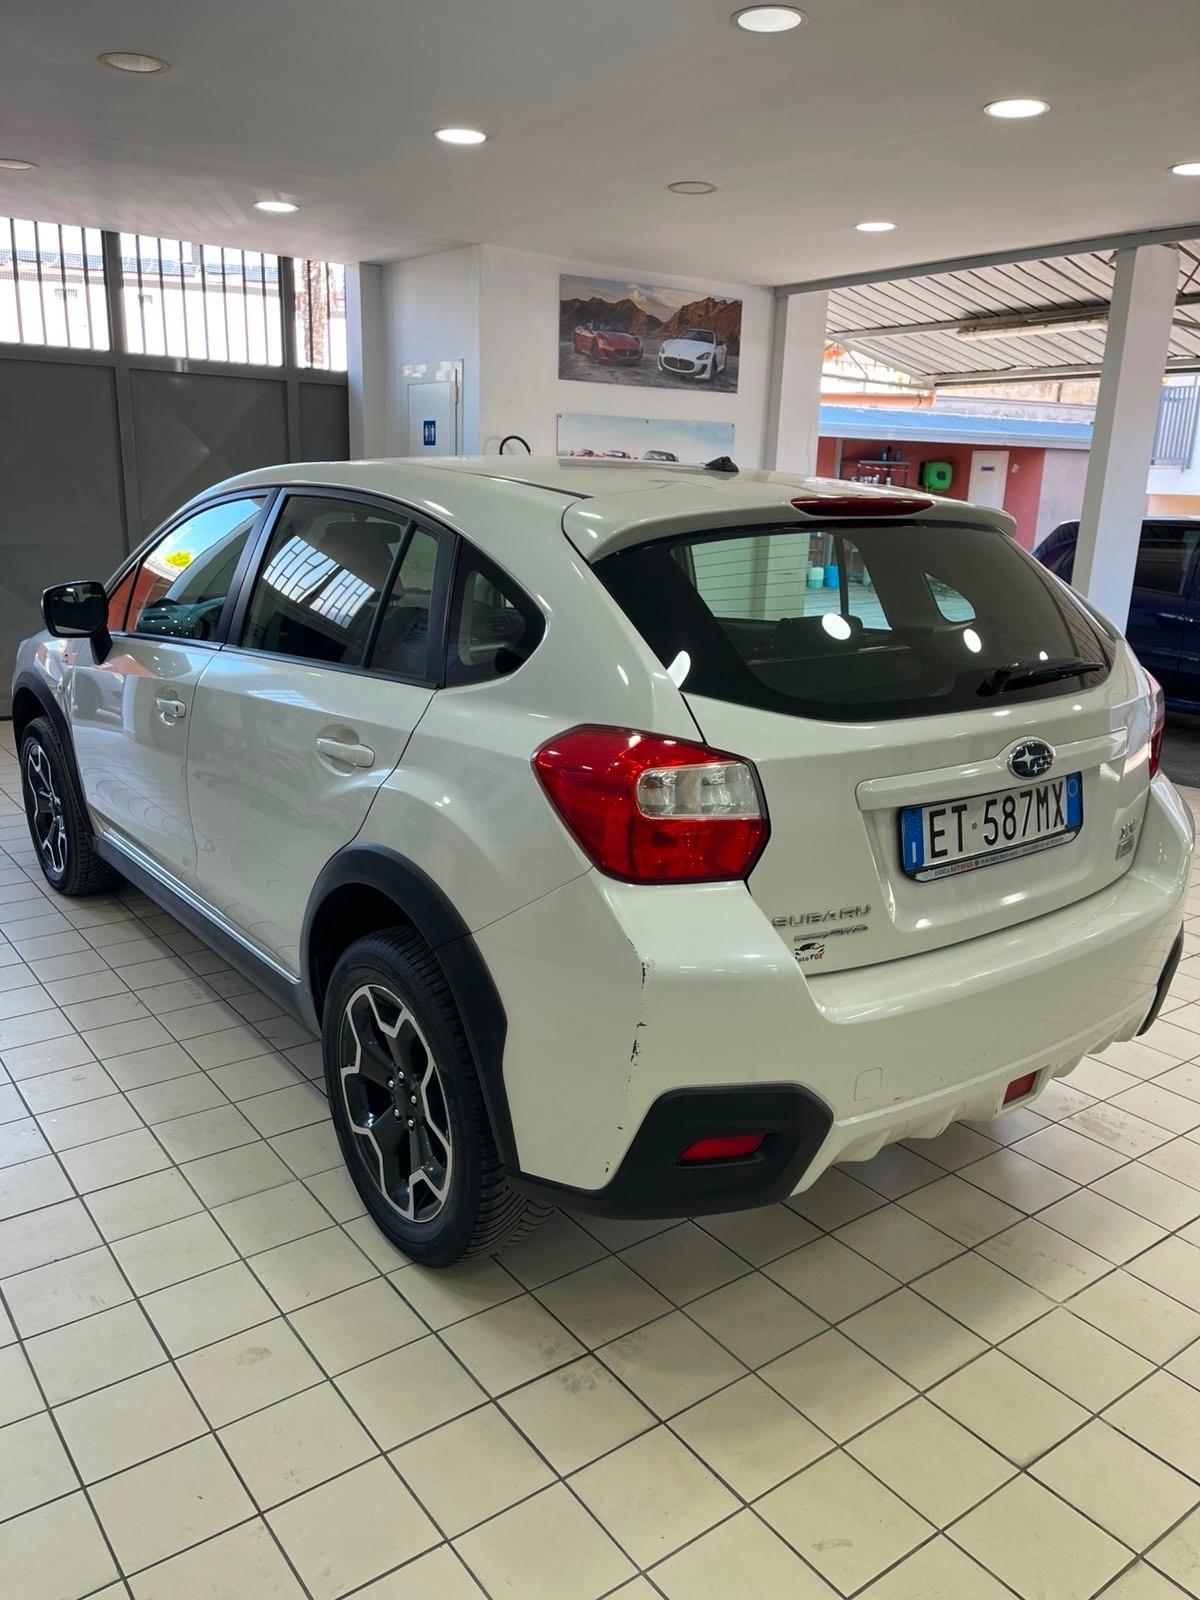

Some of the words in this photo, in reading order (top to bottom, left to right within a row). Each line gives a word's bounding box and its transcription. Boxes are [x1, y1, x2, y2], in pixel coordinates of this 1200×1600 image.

[929, 804, 968, 859] ET
[983, 781, 1065, 846] 587MX
[772, 904, 871, 927] SUBARU
